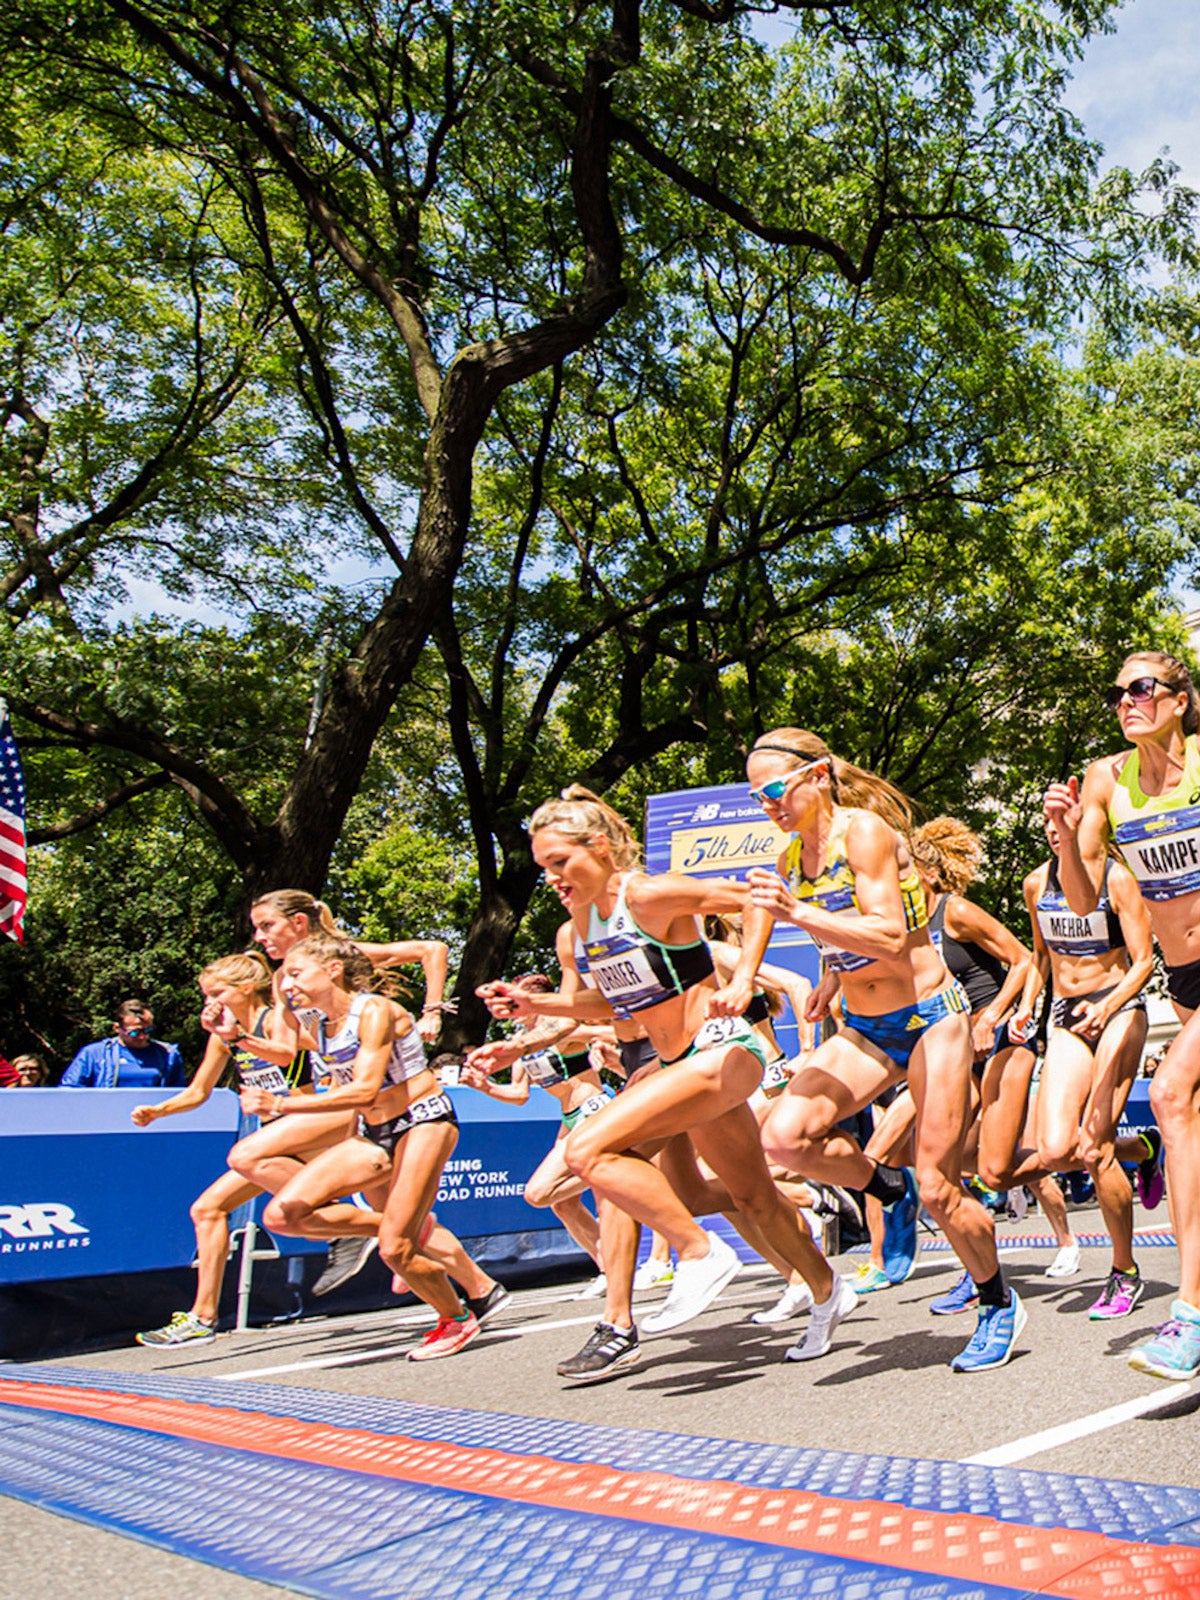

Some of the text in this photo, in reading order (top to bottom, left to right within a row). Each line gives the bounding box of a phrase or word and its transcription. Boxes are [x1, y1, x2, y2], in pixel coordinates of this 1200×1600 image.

[683, 835, 729, 867] 5th
[1138, 838, 1198, 874] KAMPF
[1050, 917, 1092, 938] MEHRA
[443, 1159, 482, 1173] SING
[439, 1171, 509, 1187] EW YORK
[436, 1188, 470, 1202] OAD
[1, 1237, 91, 1254] RUNNERS
